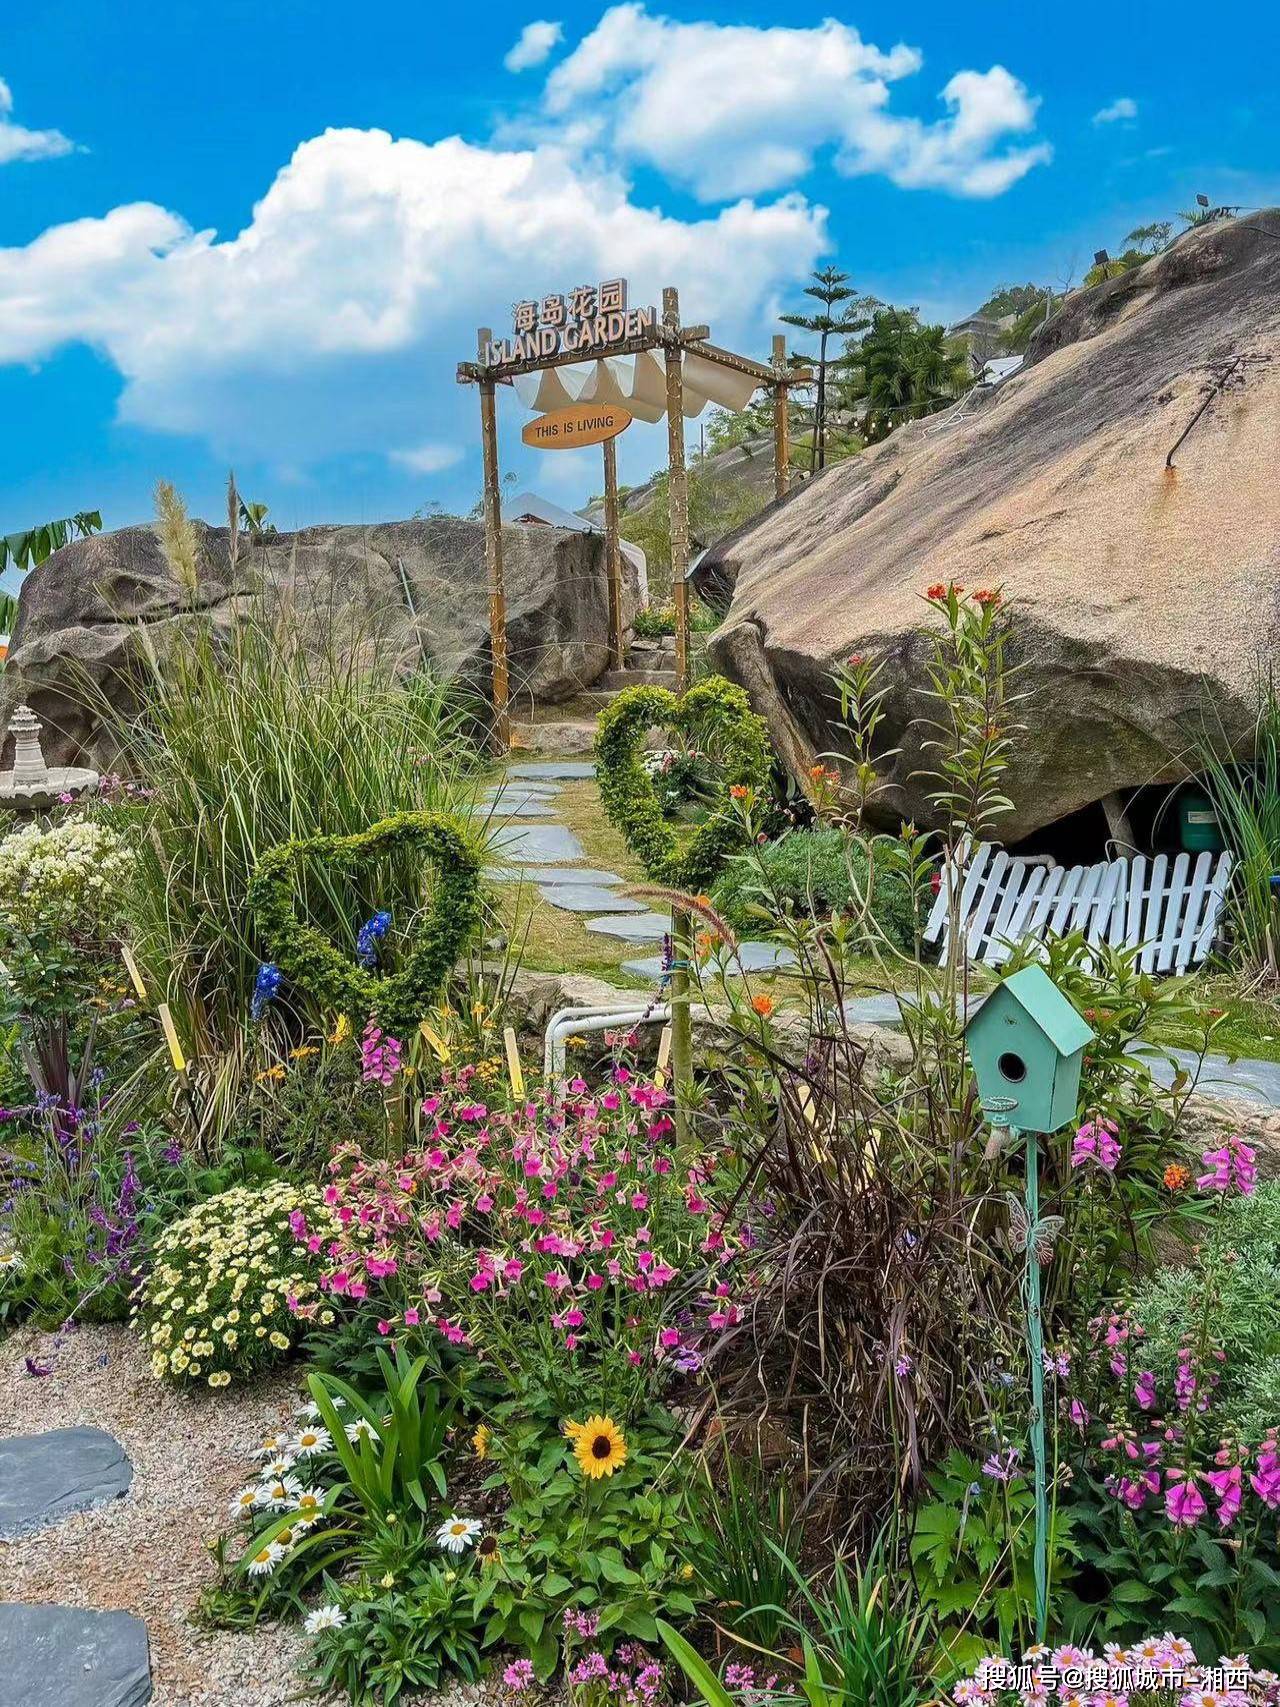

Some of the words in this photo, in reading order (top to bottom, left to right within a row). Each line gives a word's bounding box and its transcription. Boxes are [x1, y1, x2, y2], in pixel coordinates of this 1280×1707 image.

[512, 278, 627, 331] 海岛花园
[485, 327, 560, 367] ISLAND
[562, 307, 654, 350] GARDEN
[535, 424, 559, 439] THIS
[563, 421, 573, 434] IS
[577, 416, 614, 432] LIVING
